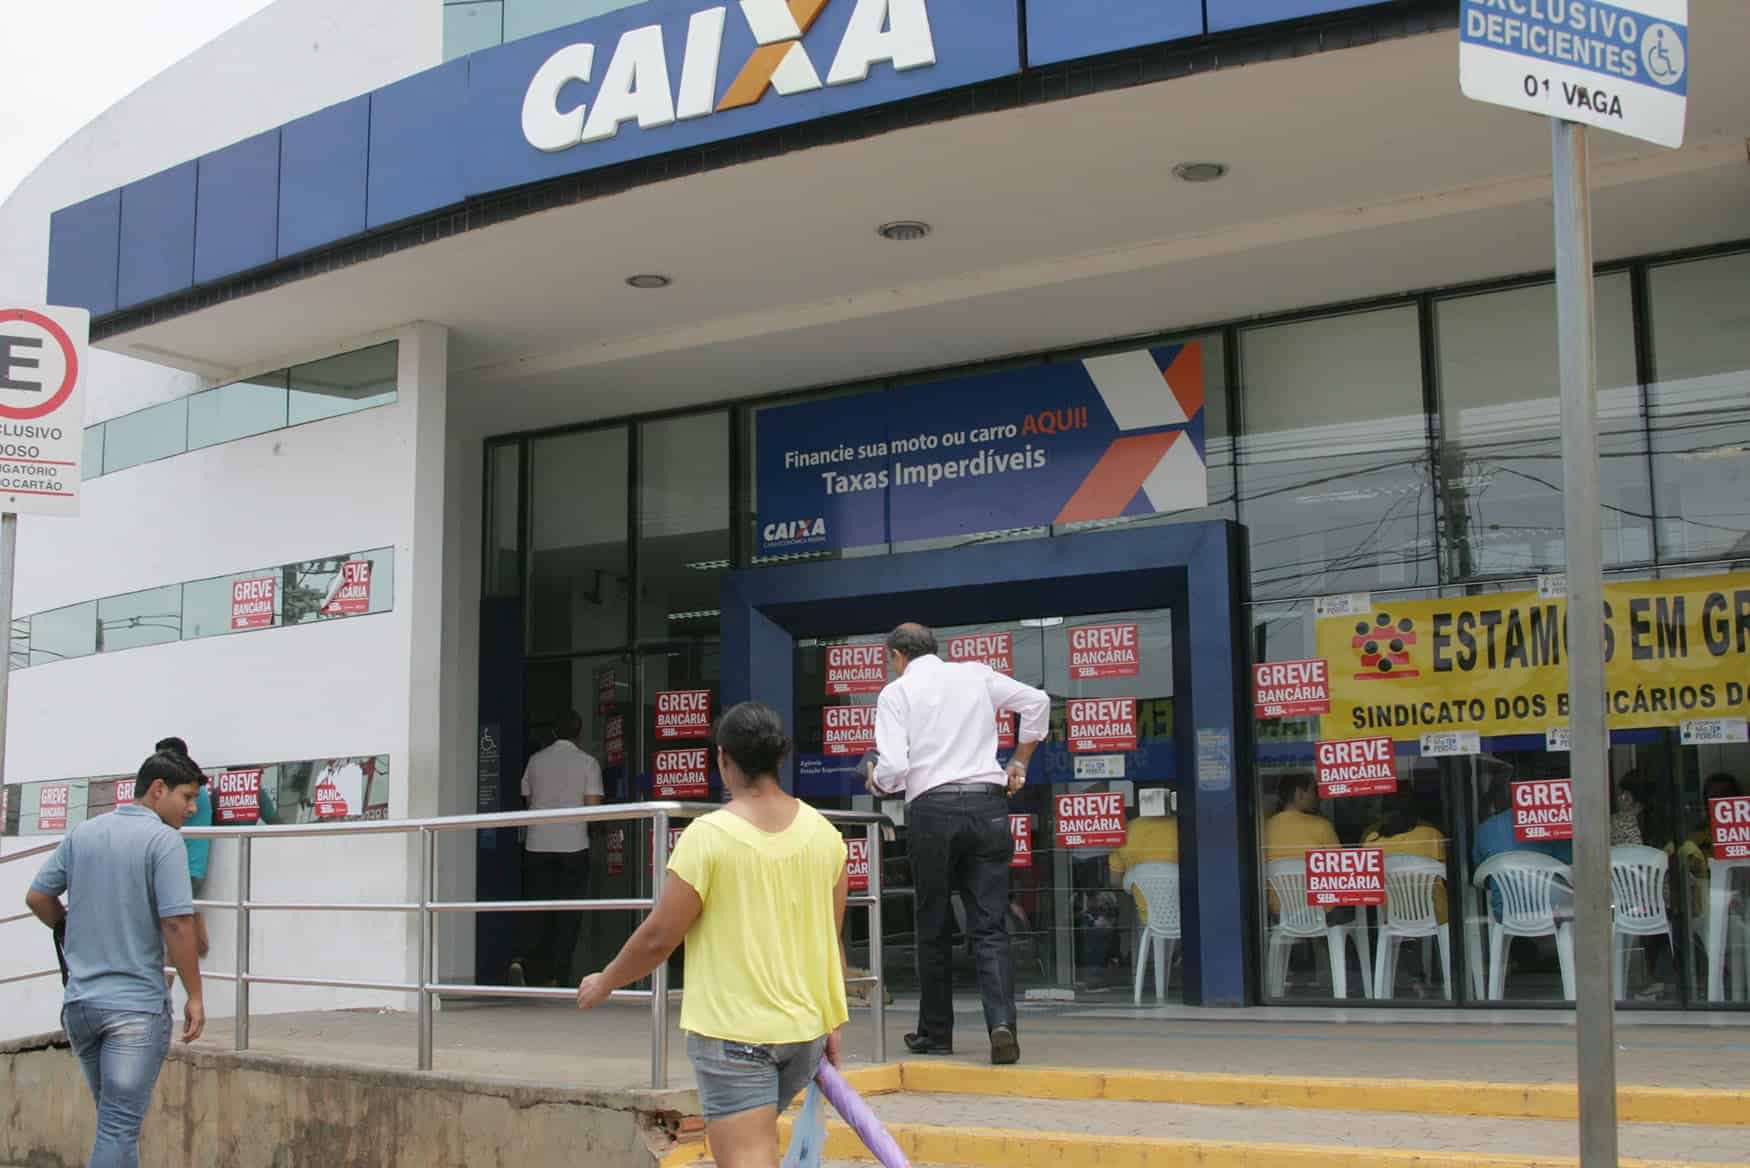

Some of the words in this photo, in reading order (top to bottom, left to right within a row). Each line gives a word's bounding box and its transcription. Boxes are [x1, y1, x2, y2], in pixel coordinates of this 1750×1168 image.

[1467, 8, 1637, 77] DEFICIENTES
[521, 0, 936, 152] CAIXA
[1562, 81, 1623, 119] VAGA
[785, 444, 854, 469] Financie
[857, 441, 888, 459] sua
[891, 433, 938, 454] moto
[942, 430, 965, 446] ou
[970, 423, 1017, 443] carro
[1021, 406, 1088, 435] AQUI!
[822, 470, 889, 495] Taxas
[895, 444, 1046, 488] Imperdíveis
[13, 479, 62, 491] CARTÃO
[763, 517, 826, 541] CAIXA
[234, 579, 273, 600] GREVE
[1072, 627, 1135, 649] GREVE
[1630, 596, 1688, 660] EM
[829, 647, 883, 667] GREVE
[951, 635, 1009, 658] GREVE
[1072, 646, 1134, 665] BANCÁRIA
[829, 664, 882, 681] BANCÁRIA
[1257, 661, 1325, 686] GREVE
[658, 693, 708, 711] GREVE
[1257, 683, 1326, 703] BANCÁRIA
[658, 710, 706, 725] BANCÁRIA
[1071, 700, 1133, 721] GREVE
[1352, 698, 1486, 729] SINDICATO
[1494, 693, 1546, 720] DOS
[1071, 720, 1132, 737] BANCÁRIA
[656, 752, 706, 770] GREVE
[1320, 739, 1390, 765] GREVE
[656, 769, 705, 785] BANCÁRIA
[1321, 761, 1392, 782] BANCÁRIA
[220, 773, 259, 792] GREVE
[219, 792, 258, 808] BANCÁRIA
[1060, 795, 1121, 816] GREVE
[1060, 815, 1121, 833] BANCÁRIA
[1310, 851, 1380, 874] GREVE
[1311, 872, 1380, 890] BANCÁRIA
